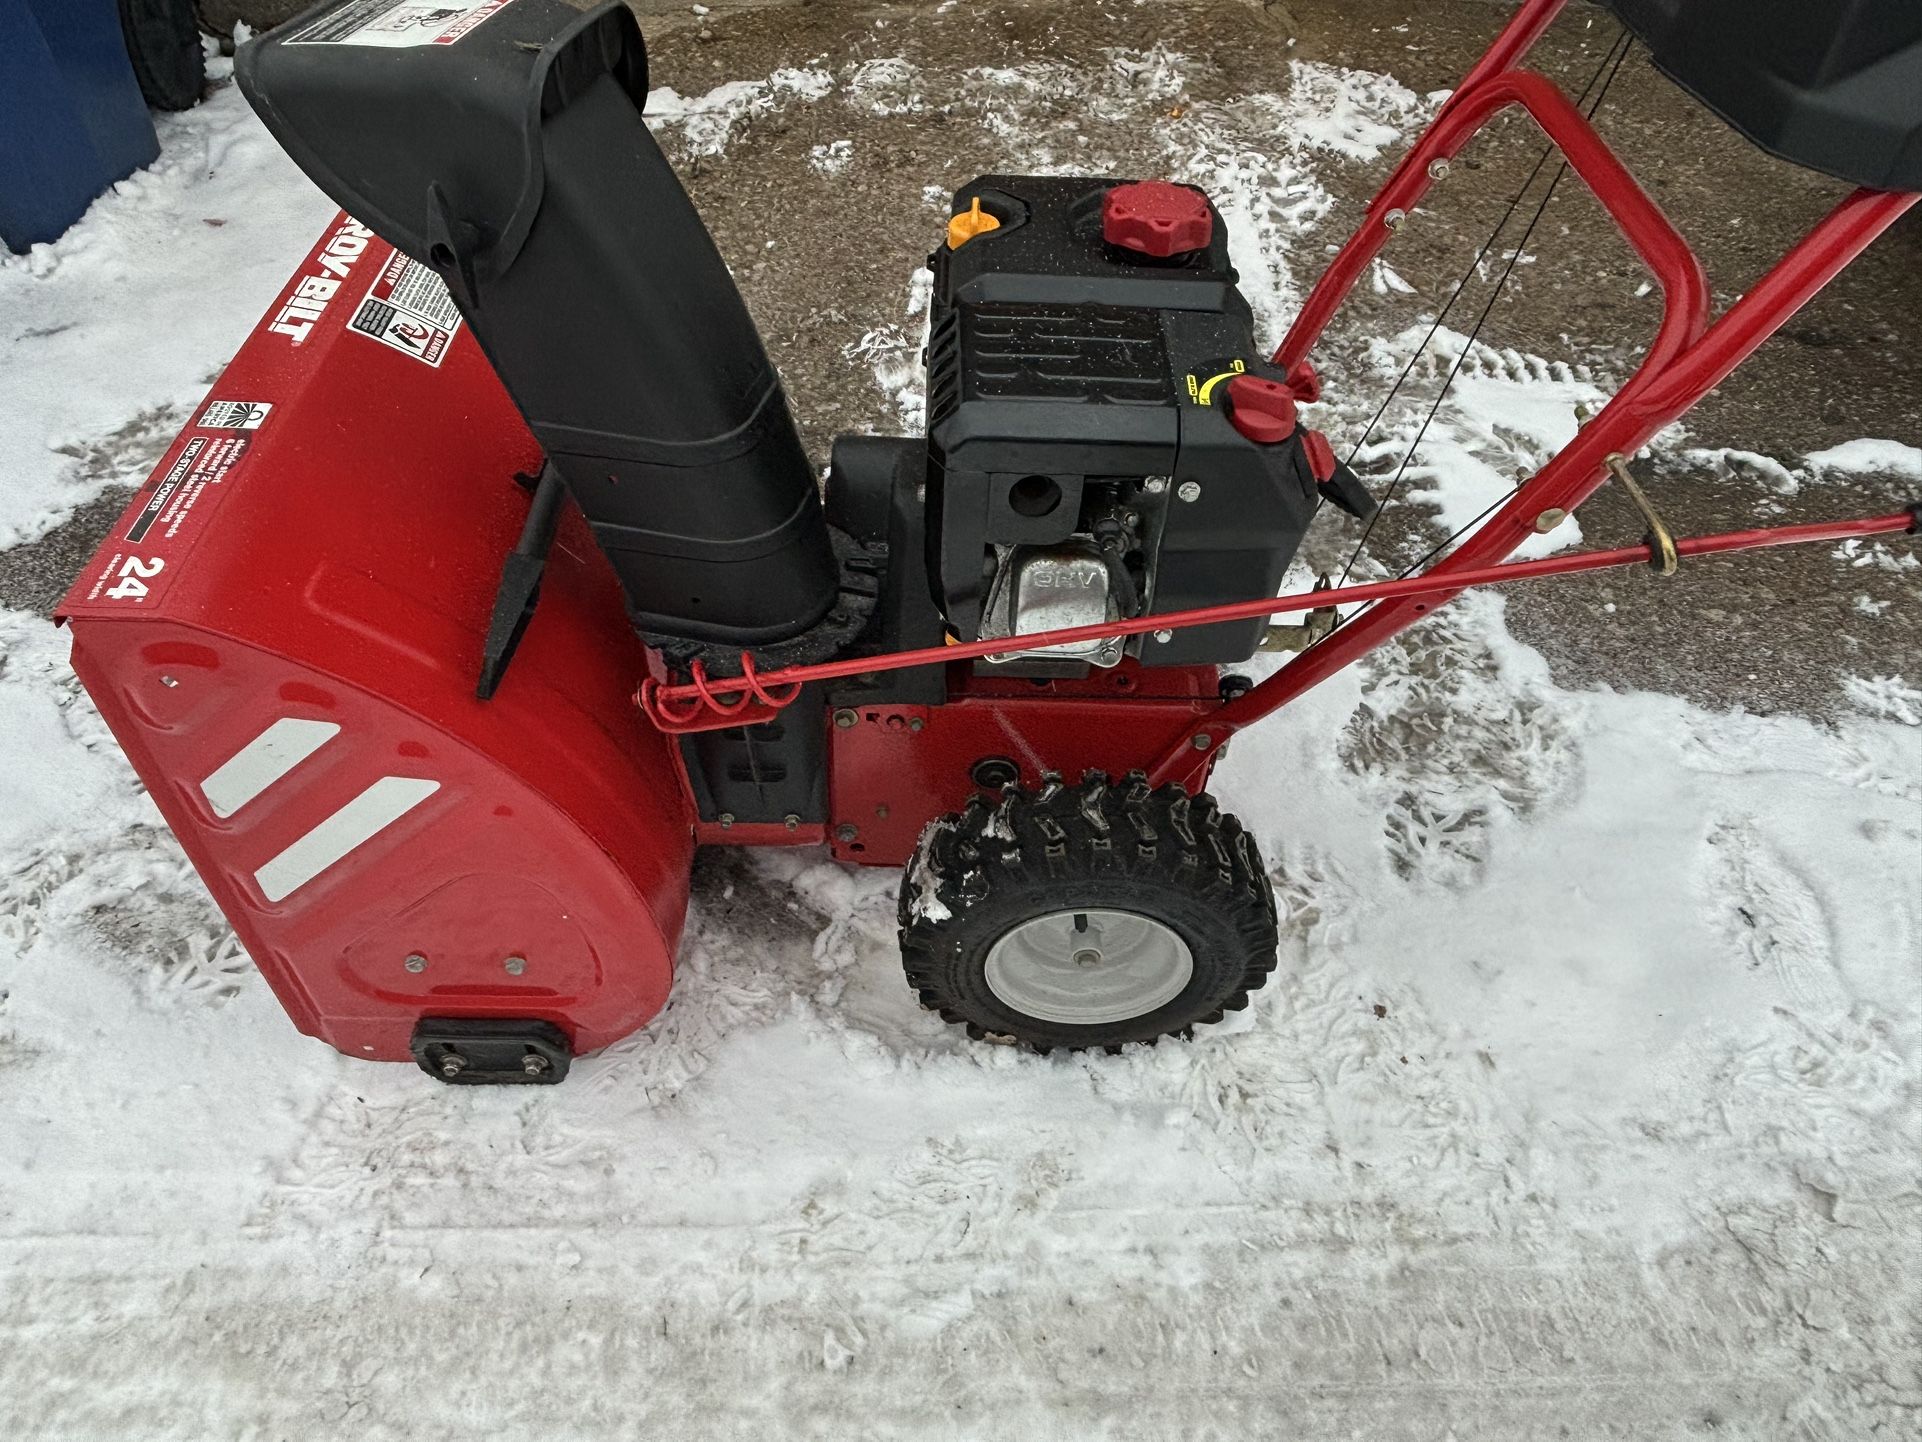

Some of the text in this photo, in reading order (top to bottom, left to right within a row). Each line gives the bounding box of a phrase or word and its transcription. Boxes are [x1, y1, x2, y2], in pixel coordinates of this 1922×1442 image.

[268, 215, 375, 343] ROY-BILT
[391, 251, 411, 280] DANGE
[194, 438, 222, 473] reinforced
[208, 444, 233, 472] forward
[224, 439, 246, 466] electric
[148, 440, 204, 511] TWO-STAGE POWER
[181, 474, 199, 492] steel
[212, 466, 228, 483] start
[160, 493, 189, 522] housing
[184, 482, 206, 509] reverse
[165, 510, 188, 538] speeds
